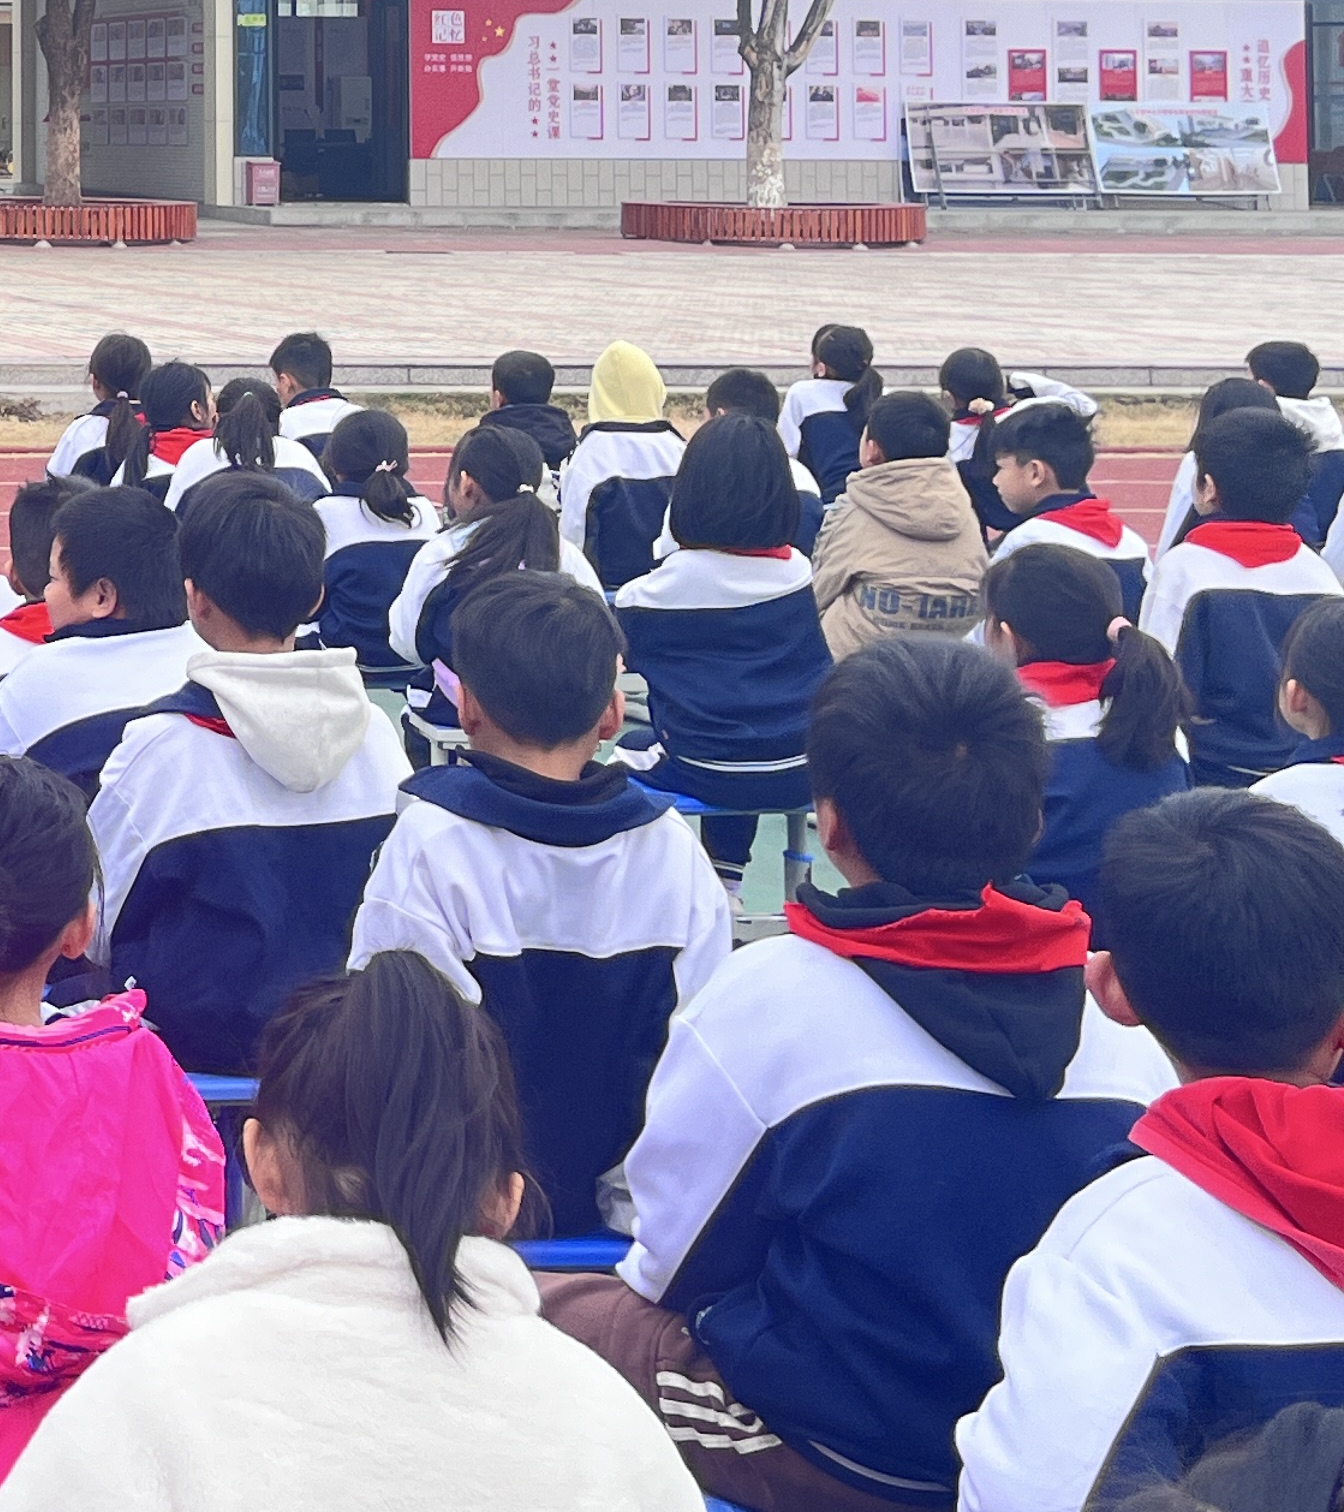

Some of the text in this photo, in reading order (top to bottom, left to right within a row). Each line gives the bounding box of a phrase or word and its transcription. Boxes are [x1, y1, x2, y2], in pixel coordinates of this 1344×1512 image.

[528, 35, 541, 113] 习总书记的
[546, 67, 561, 140] 一堂党史课
[1240, 68, 1254, 102] 重大
